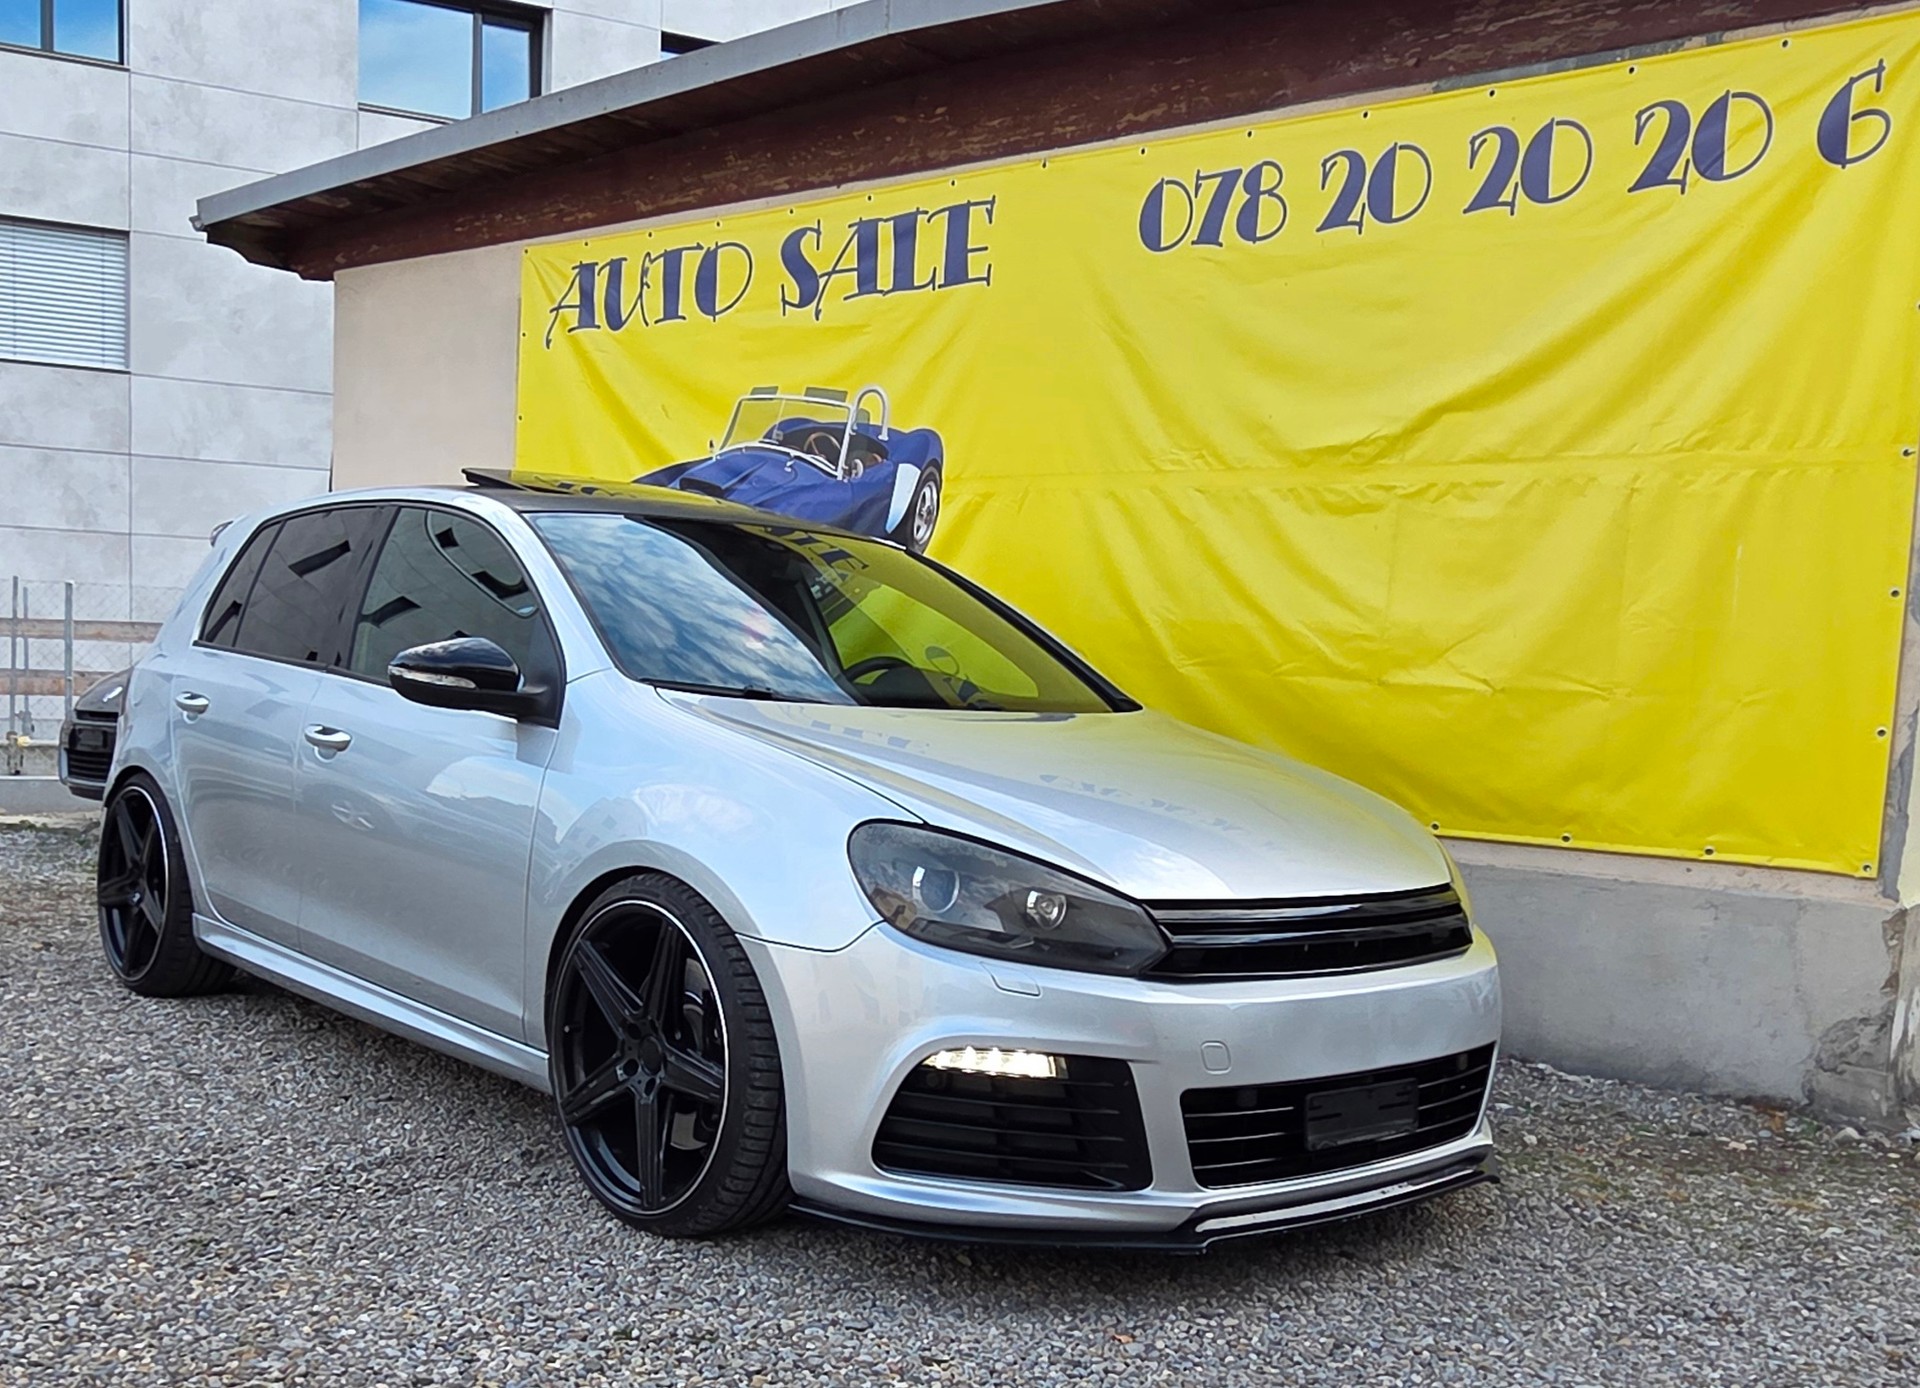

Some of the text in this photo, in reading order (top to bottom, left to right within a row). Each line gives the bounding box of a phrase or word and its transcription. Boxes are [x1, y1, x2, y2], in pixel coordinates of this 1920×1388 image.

[1138, 58, 1892, 253] 078 20 20 20 6
[545, 194, 997, 349] AUTO SALE
